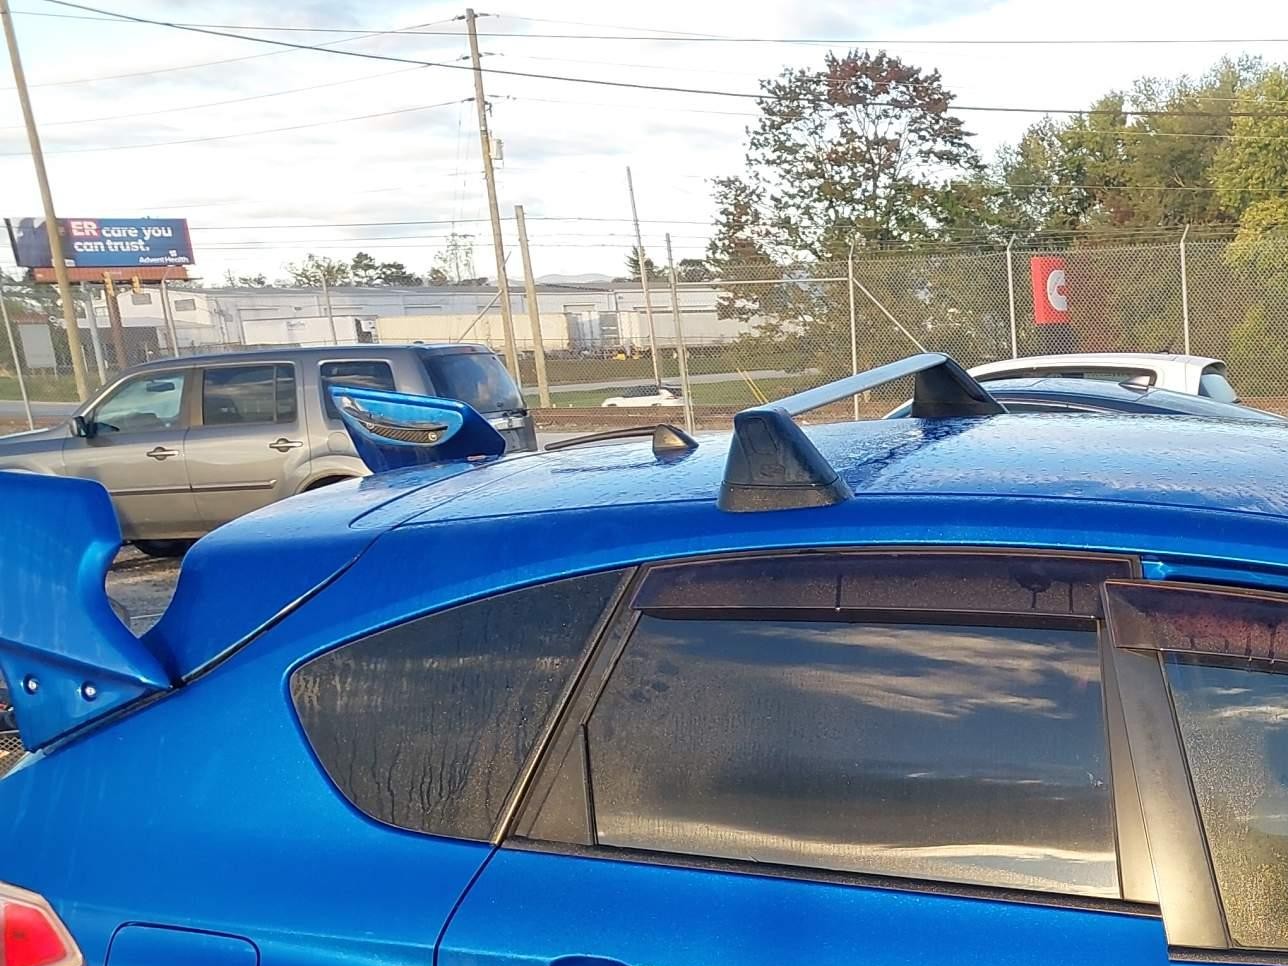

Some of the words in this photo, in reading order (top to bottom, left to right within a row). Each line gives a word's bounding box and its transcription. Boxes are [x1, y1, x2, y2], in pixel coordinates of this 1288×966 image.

[70, 221, 97, 236] ER
[102, 226, 138, 237] care
[143, 226, 172, 240] you
[74, 239, 105, 252] can
[106, 239, 150, 252] trust.
[139, 256, 189, 264] AdventHealth
